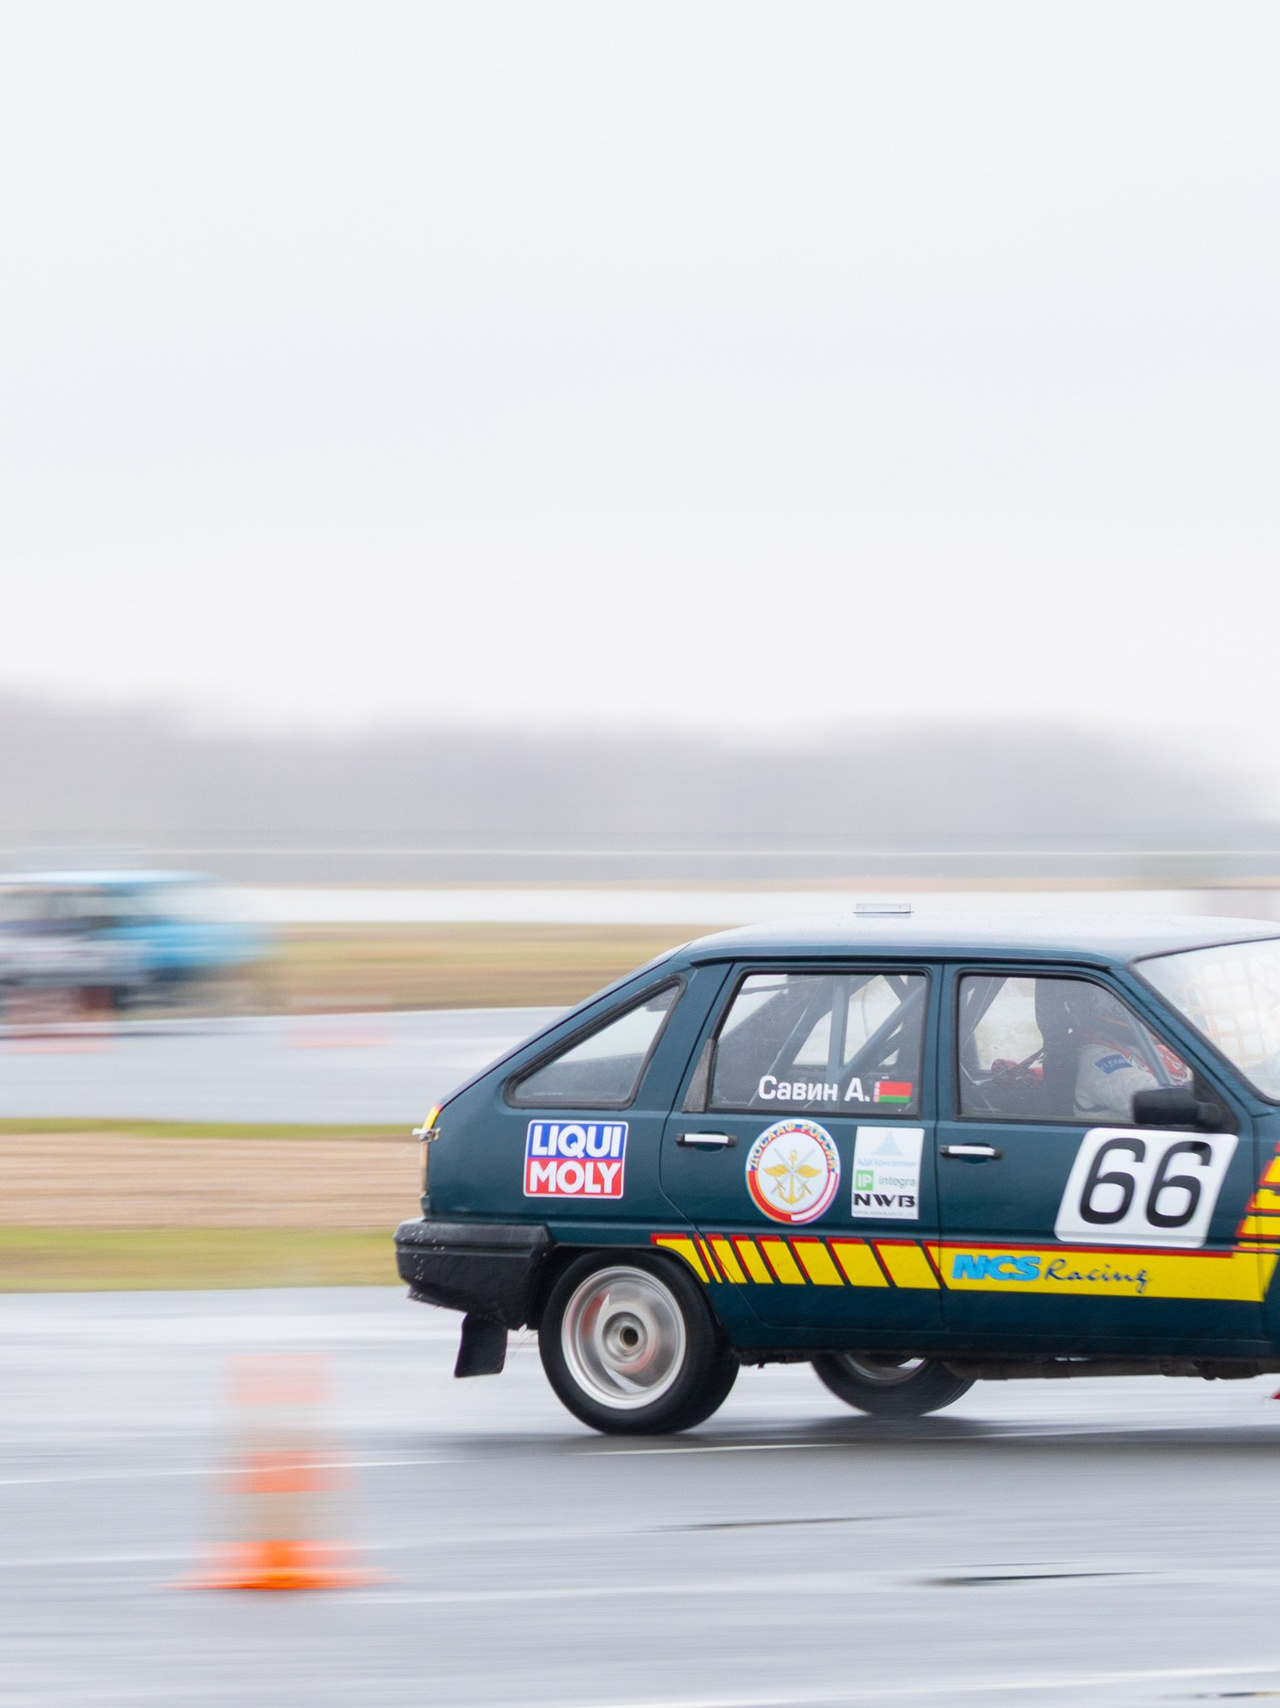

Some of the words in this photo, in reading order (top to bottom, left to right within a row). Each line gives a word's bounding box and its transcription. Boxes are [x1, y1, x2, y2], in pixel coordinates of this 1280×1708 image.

[758, 1074, 838, 1102] Савин
[531, 1124, 622, 1159] LIQUI
[748, 1121, 796, 1168] ДОСААФ
[801, 1122, 838, 1168] РОССИИ
[529, 1160, 621, 1195] MOLY
[878, 1174, 916, 1189] integra
[1079, 1137, 1212, 1229] 66
[853, 1193, 916, 1208] NWB
[951, 1254, 1041, 1282] NCS
[1043, 1257, 1153, 1294] Racing
